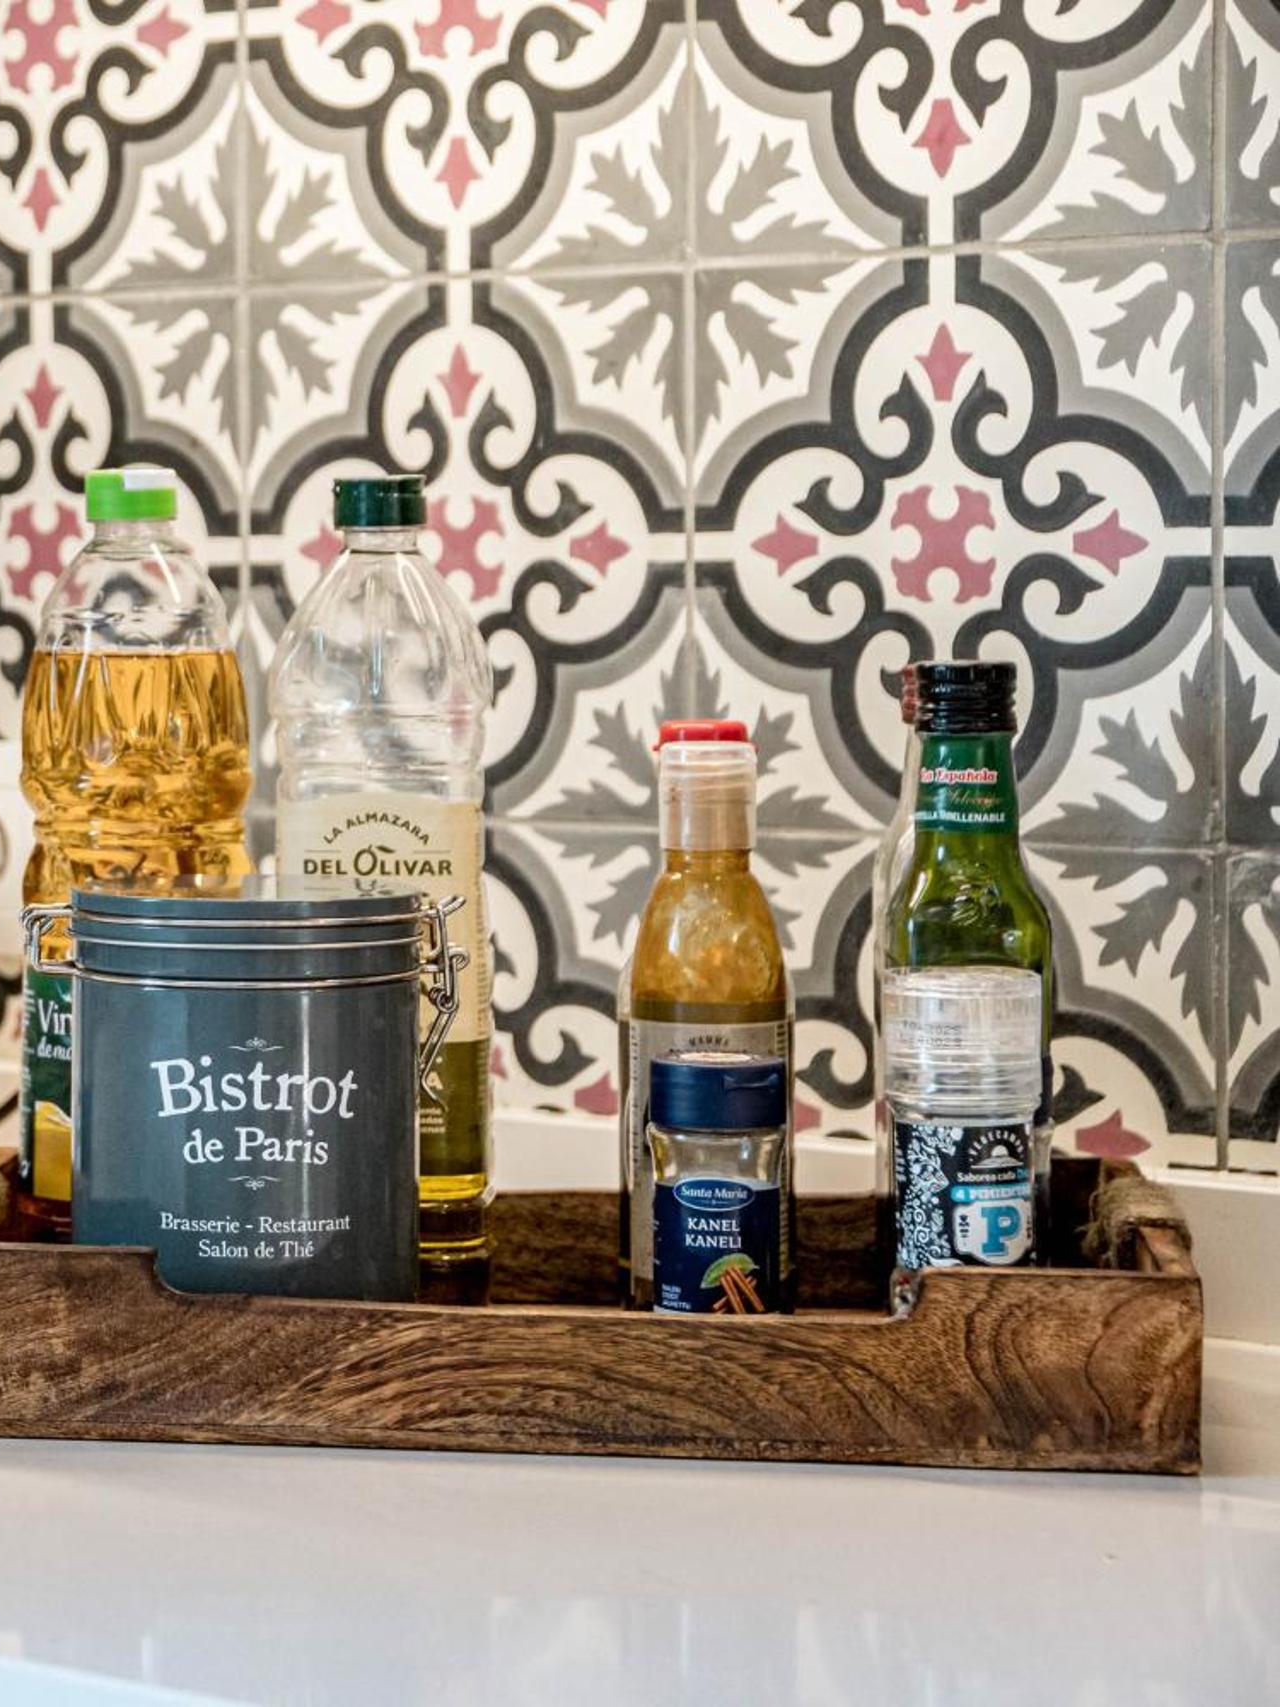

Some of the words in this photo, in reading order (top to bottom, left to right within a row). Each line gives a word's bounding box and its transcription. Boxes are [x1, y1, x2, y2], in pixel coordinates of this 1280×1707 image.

[323, 826, 343, 845] LA
[346, 811, 430, 846] ALMAZARA
[304, 859, 348, 876] DEL
[353, 845, 453, 877] OLIVAR
[150, 1055, 359, 1119] Bistrot
[182, 1128, 225, 1165] de
[233, 1126, 329, 1165] Paris
[681, 1185, 713, 1199] Santa
[160, 1211, 241, 1234] Brasserie
[258, 1215, 351, 1234] Restaurant
[687, 1217, 741, 1233] KANEL
[980, 1205, 1021, 1257] P
[198, 1239, 249, 1259] Salon
[253, 1240, 275, 1259] de
[279, 1239, 315, 1259] Thé
[685, 1233, 742, 1250] KANELI
